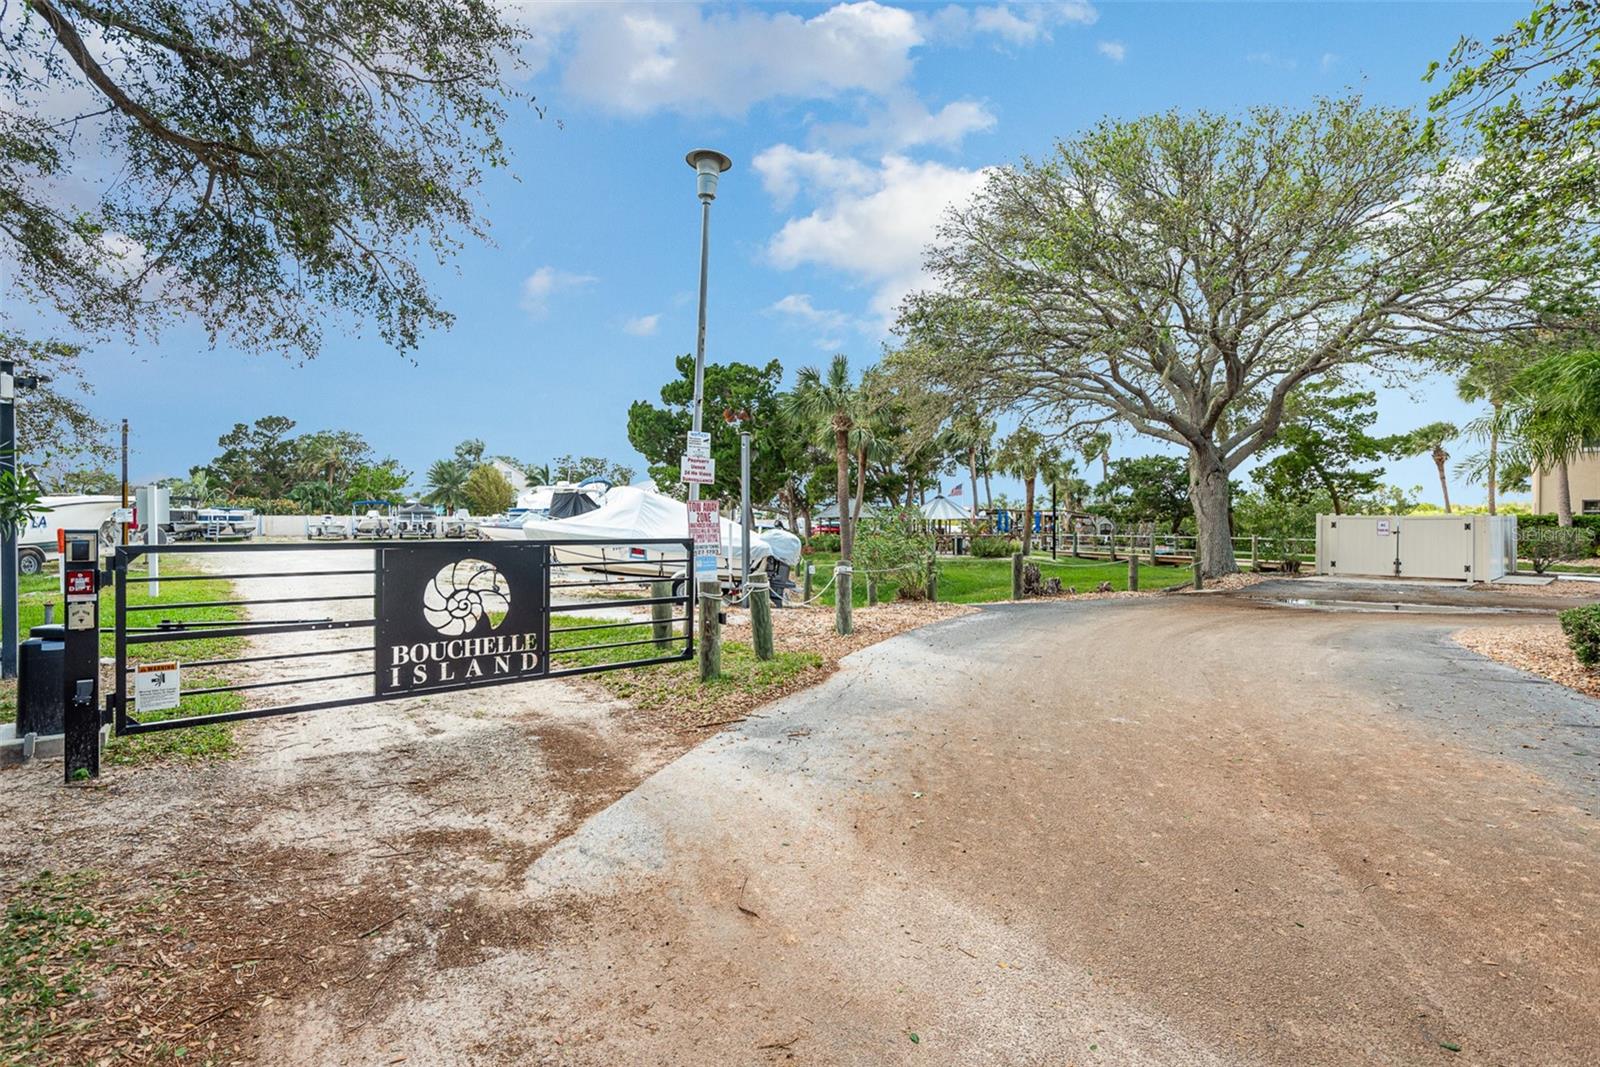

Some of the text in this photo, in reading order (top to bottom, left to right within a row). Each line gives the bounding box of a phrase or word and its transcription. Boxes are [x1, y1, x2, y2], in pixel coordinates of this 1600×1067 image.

[688, 502, 717, 512] TOW AWAY
[696, 512, 712, 523] ZONE
[391, 633, 538, 666] BOUCHELLE
[147, 663, 176, 672] WARNING
[389, 652, 538, 687] ISLAND
